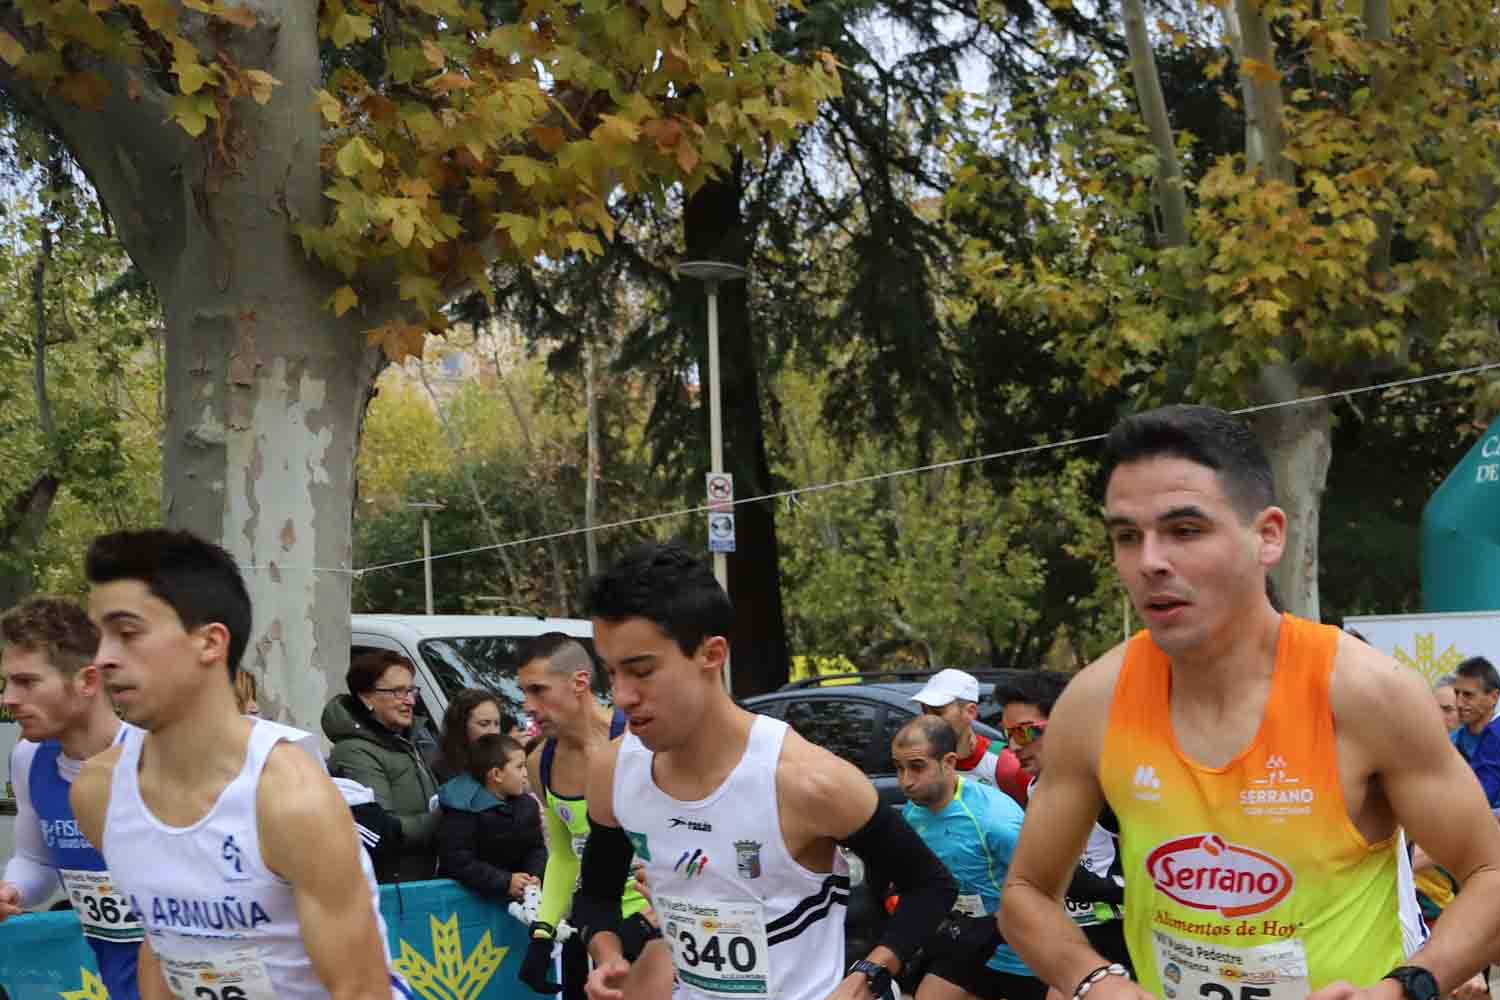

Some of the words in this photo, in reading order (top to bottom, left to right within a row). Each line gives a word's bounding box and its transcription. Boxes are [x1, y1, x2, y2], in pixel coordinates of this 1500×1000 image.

[1475, 465, 1499, 484] DE
[1239, 788, 1314, 804] SERRANO
[1158, 856, 1280, 895] Serrano
[152, 895, 272, 930] ARMUÑA
[1153, 911, 1232, 937] Alimentos
[1235, 920, 1258, 937] de
[679, 930, 757, 973] 340
